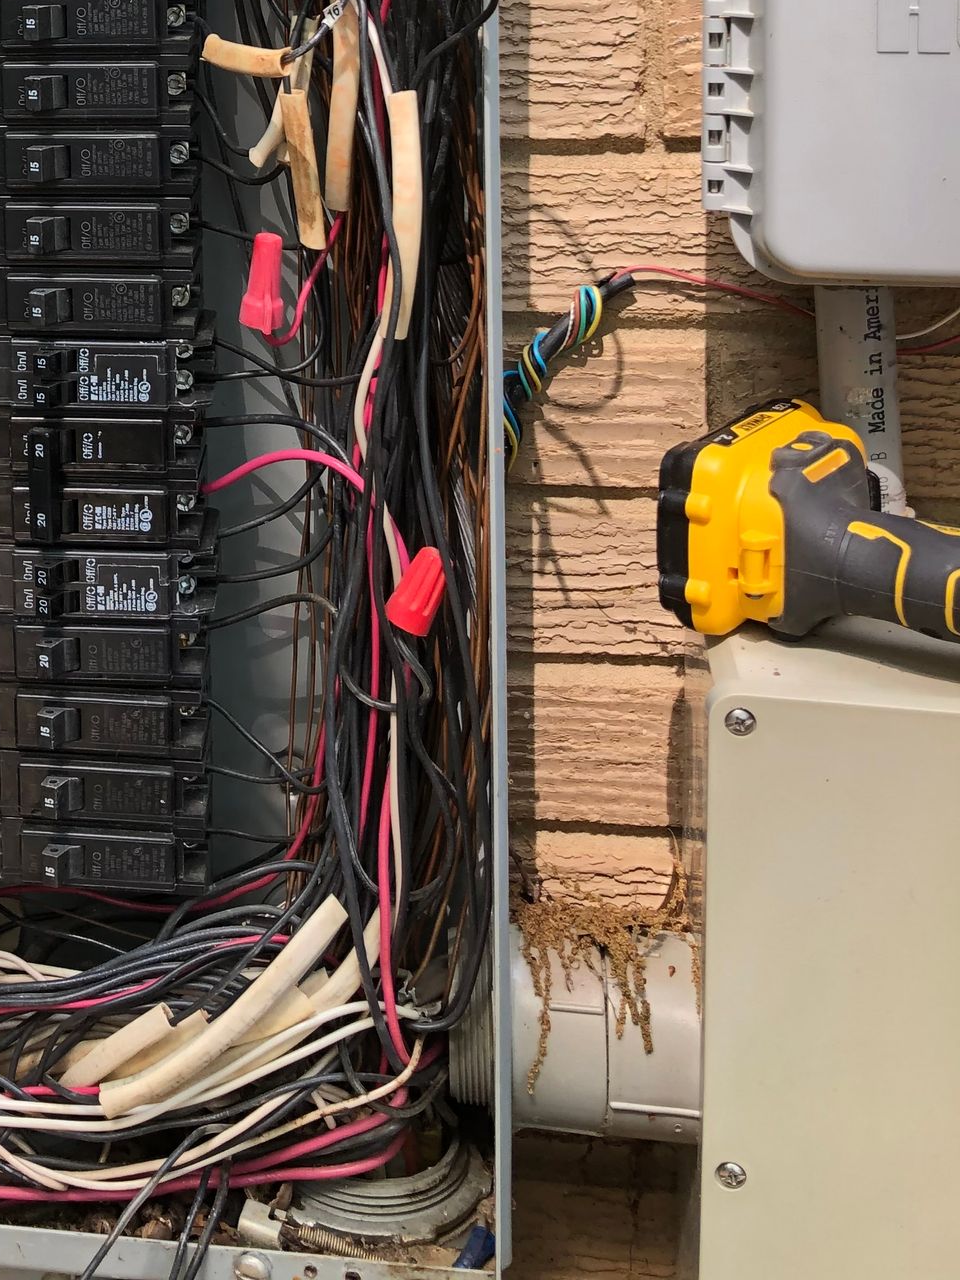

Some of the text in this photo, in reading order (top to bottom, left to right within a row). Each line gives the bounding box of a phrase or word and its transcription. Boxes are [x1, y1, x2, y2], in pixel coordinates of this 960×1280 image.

[326, 3, 341, 18] 16
[26, 18, 35, 28] 15
[28, 90, 38, 100] 15
[30, 162, 39, 172] 15
[30, 235, 39, 245] 15
[32, 307, 42, 317] 15
[37, 358, 46, 369] 15
[864, 352, 883, 375] in
[37, 393, 45, 403] 15
[867, 387, 886, 433] Made
[35, 444, 44, 457] 20
[871, 451, 887, 461] B
[37, 514, 46, 528] 20
[38, 571, 47, 585] 20
[39, 599, 48, 614] 20
[39, 655, 49, 668] 20
[40, 726, 50, 737] 15
[45, 798, 54, 808] 15
[46, 866, 55, 877] 15
